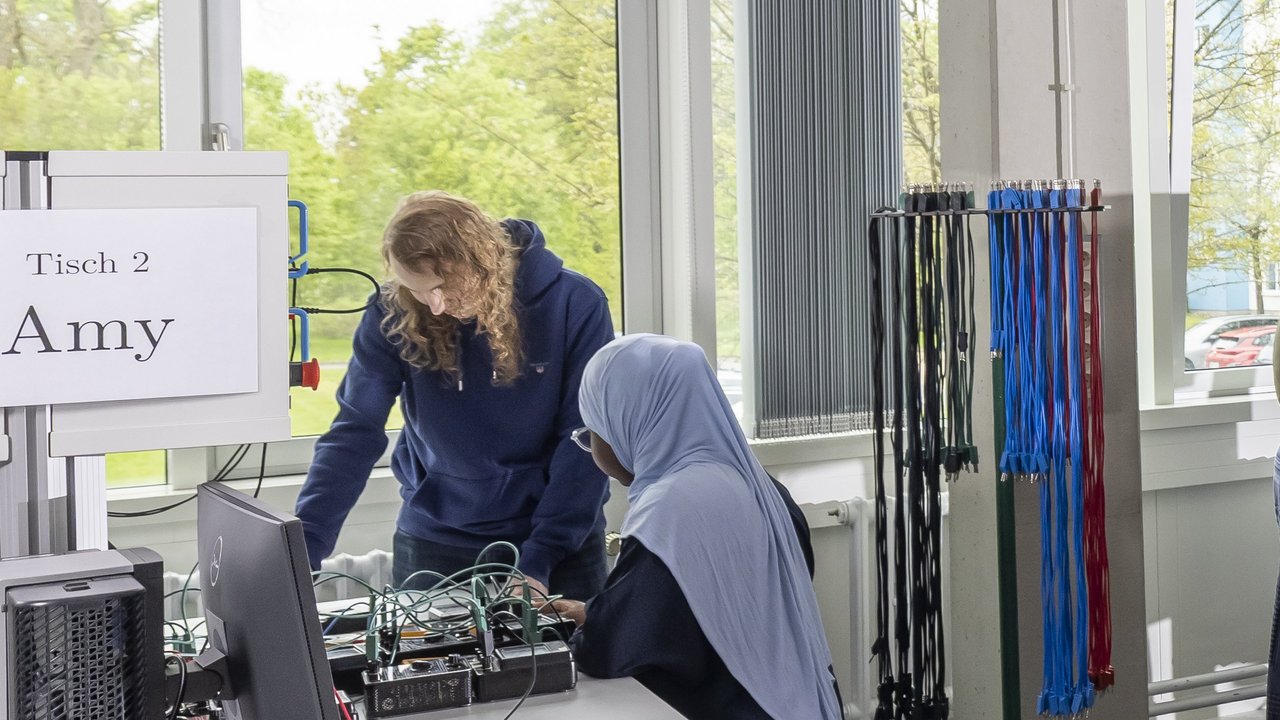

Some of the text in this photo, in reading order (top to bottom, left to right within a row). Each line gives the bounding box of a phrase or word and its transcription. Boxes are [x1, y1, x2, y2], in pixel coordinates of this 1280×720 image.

[26, 252, 149, 275] Tisch 2
[1, 305, 175, 362] Amy
